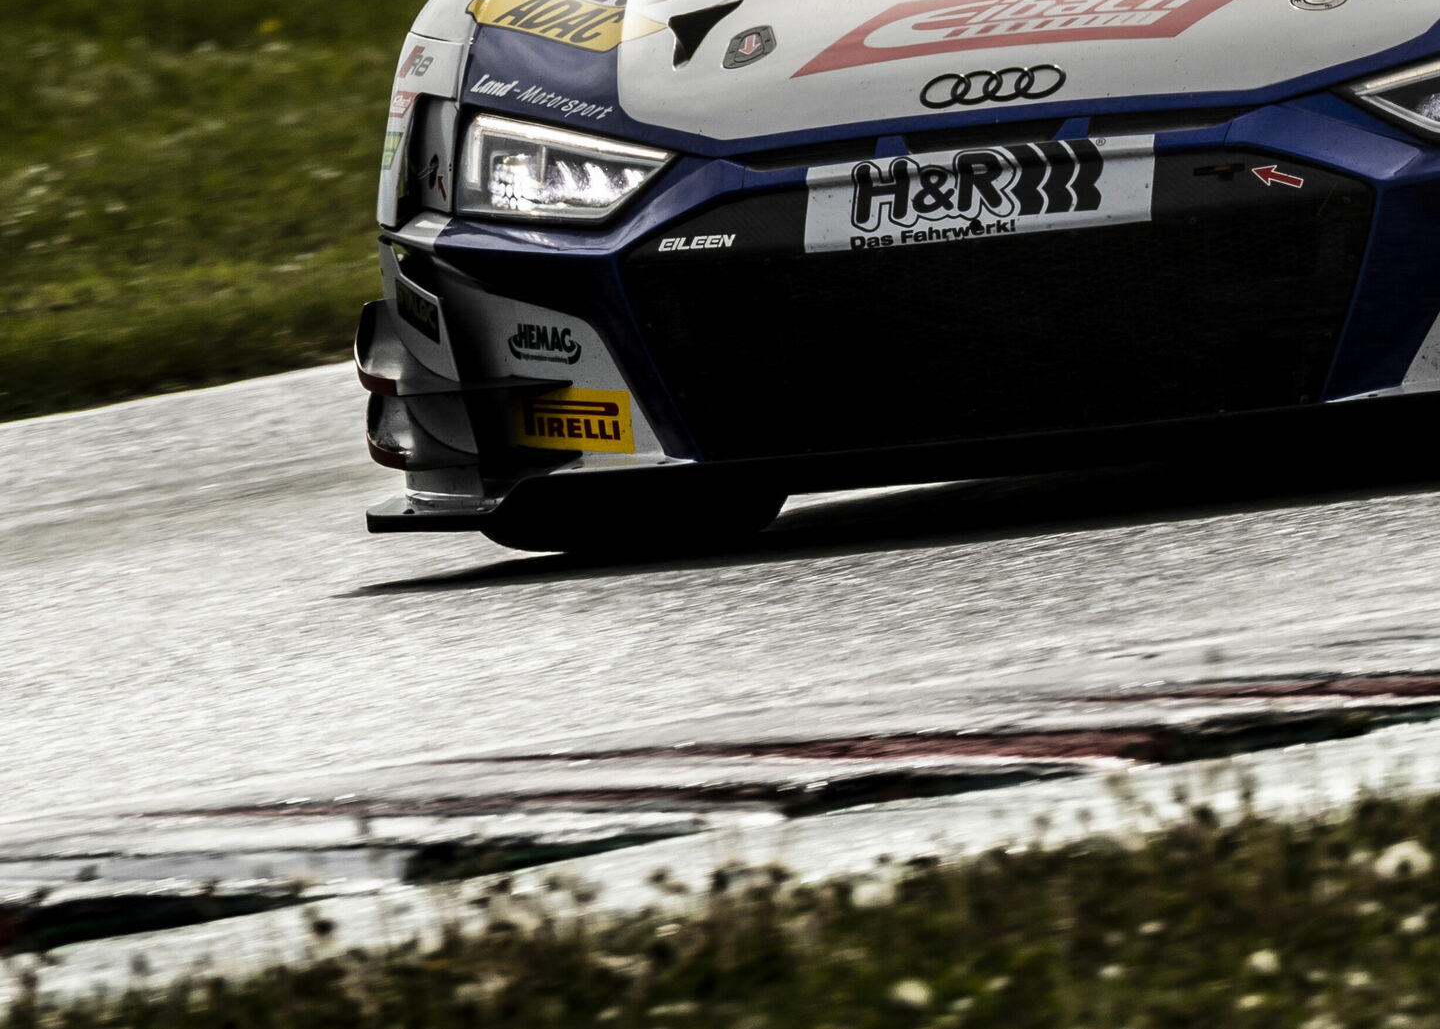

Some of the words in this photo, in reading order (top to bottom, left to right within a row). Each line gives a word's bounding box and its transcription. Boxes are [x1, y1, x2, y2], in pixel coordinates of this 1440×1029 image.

[849, 149, 1010, 231] H&R
[658, 233, 737, 252] EILEEN
[850, 233, 895, 250] Das
[898, 218, 1017, 244] Fahrwerk!
[524, 399, 622, 441] PIRELLI
